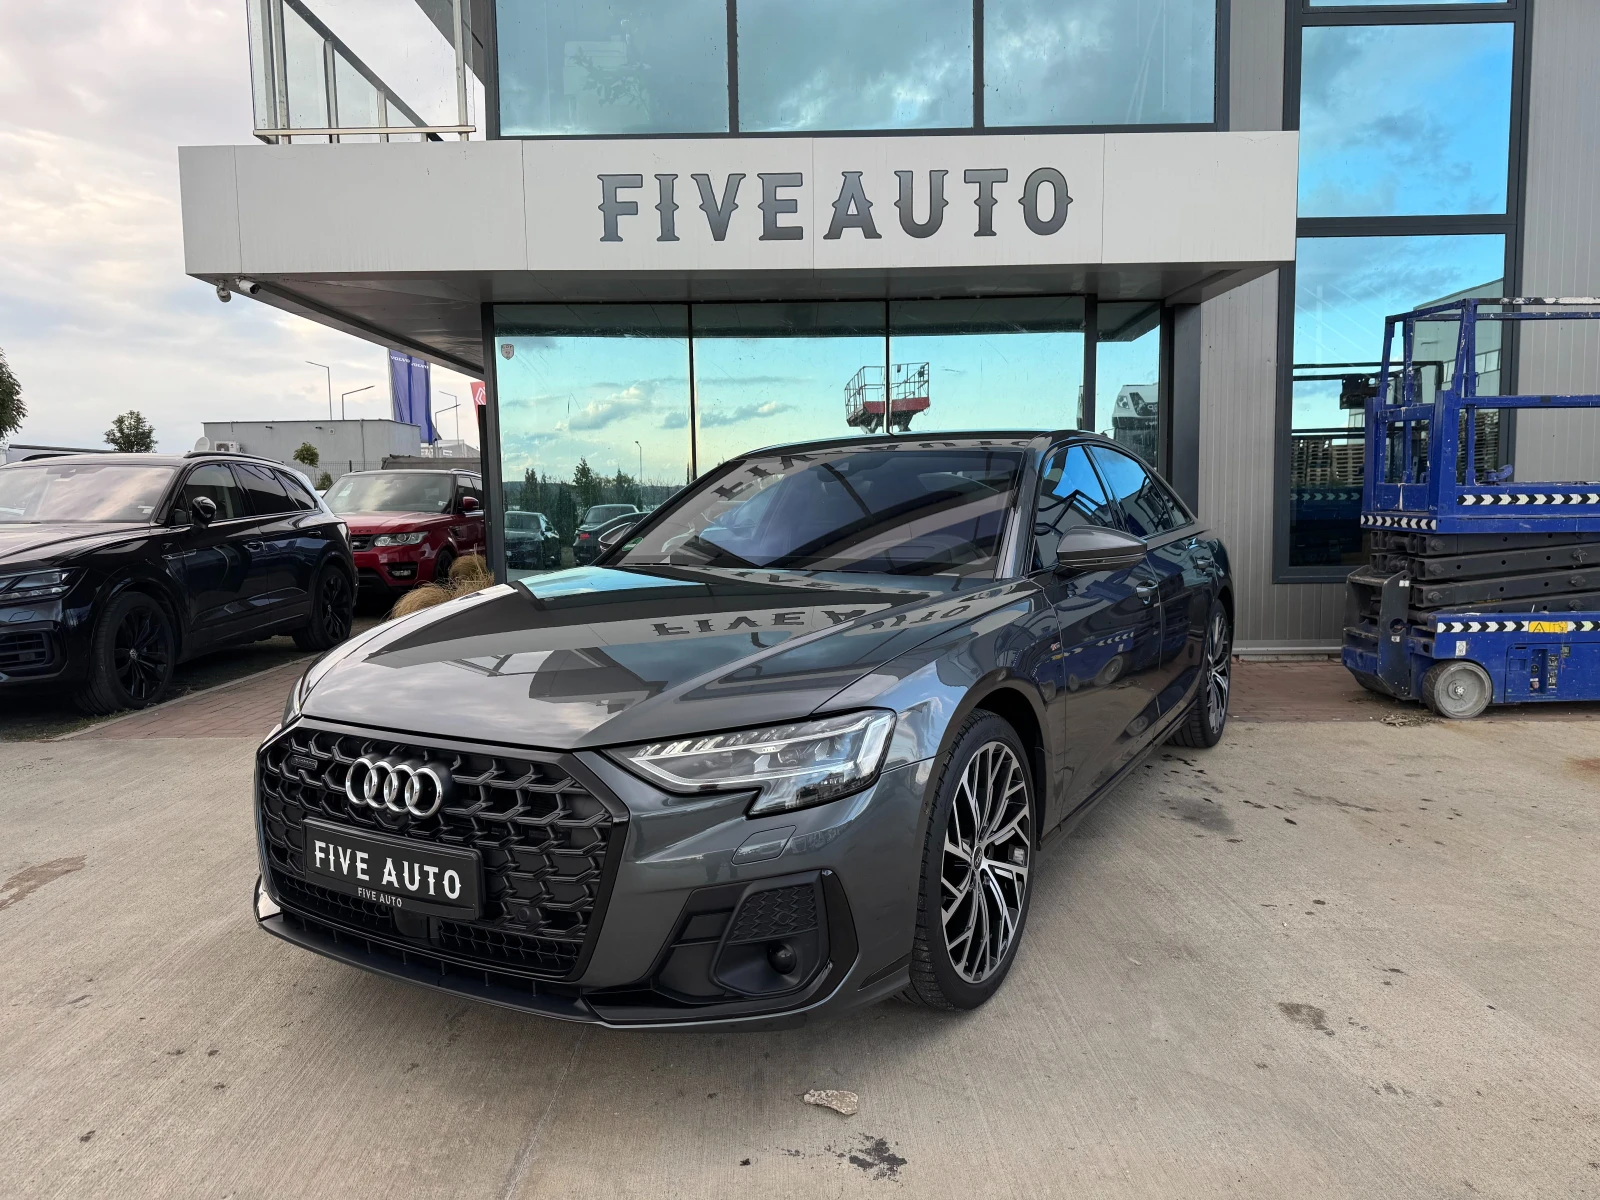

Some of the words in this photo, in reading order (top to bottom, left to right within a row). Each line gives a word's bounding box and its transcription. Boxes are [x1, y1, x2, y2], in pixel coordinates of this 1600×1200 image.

[597, 172, 804, 242] FIVE
[822, 167, 1074, 240] AUTO
[391, 355, 410, 363] VOLVO
[314, 840, 370, 881] FIVE
[381, 857, 462, 900] AUTO
[358, 887, 377, 901] FIVE
[379, 894, 403, 908] AUTO
